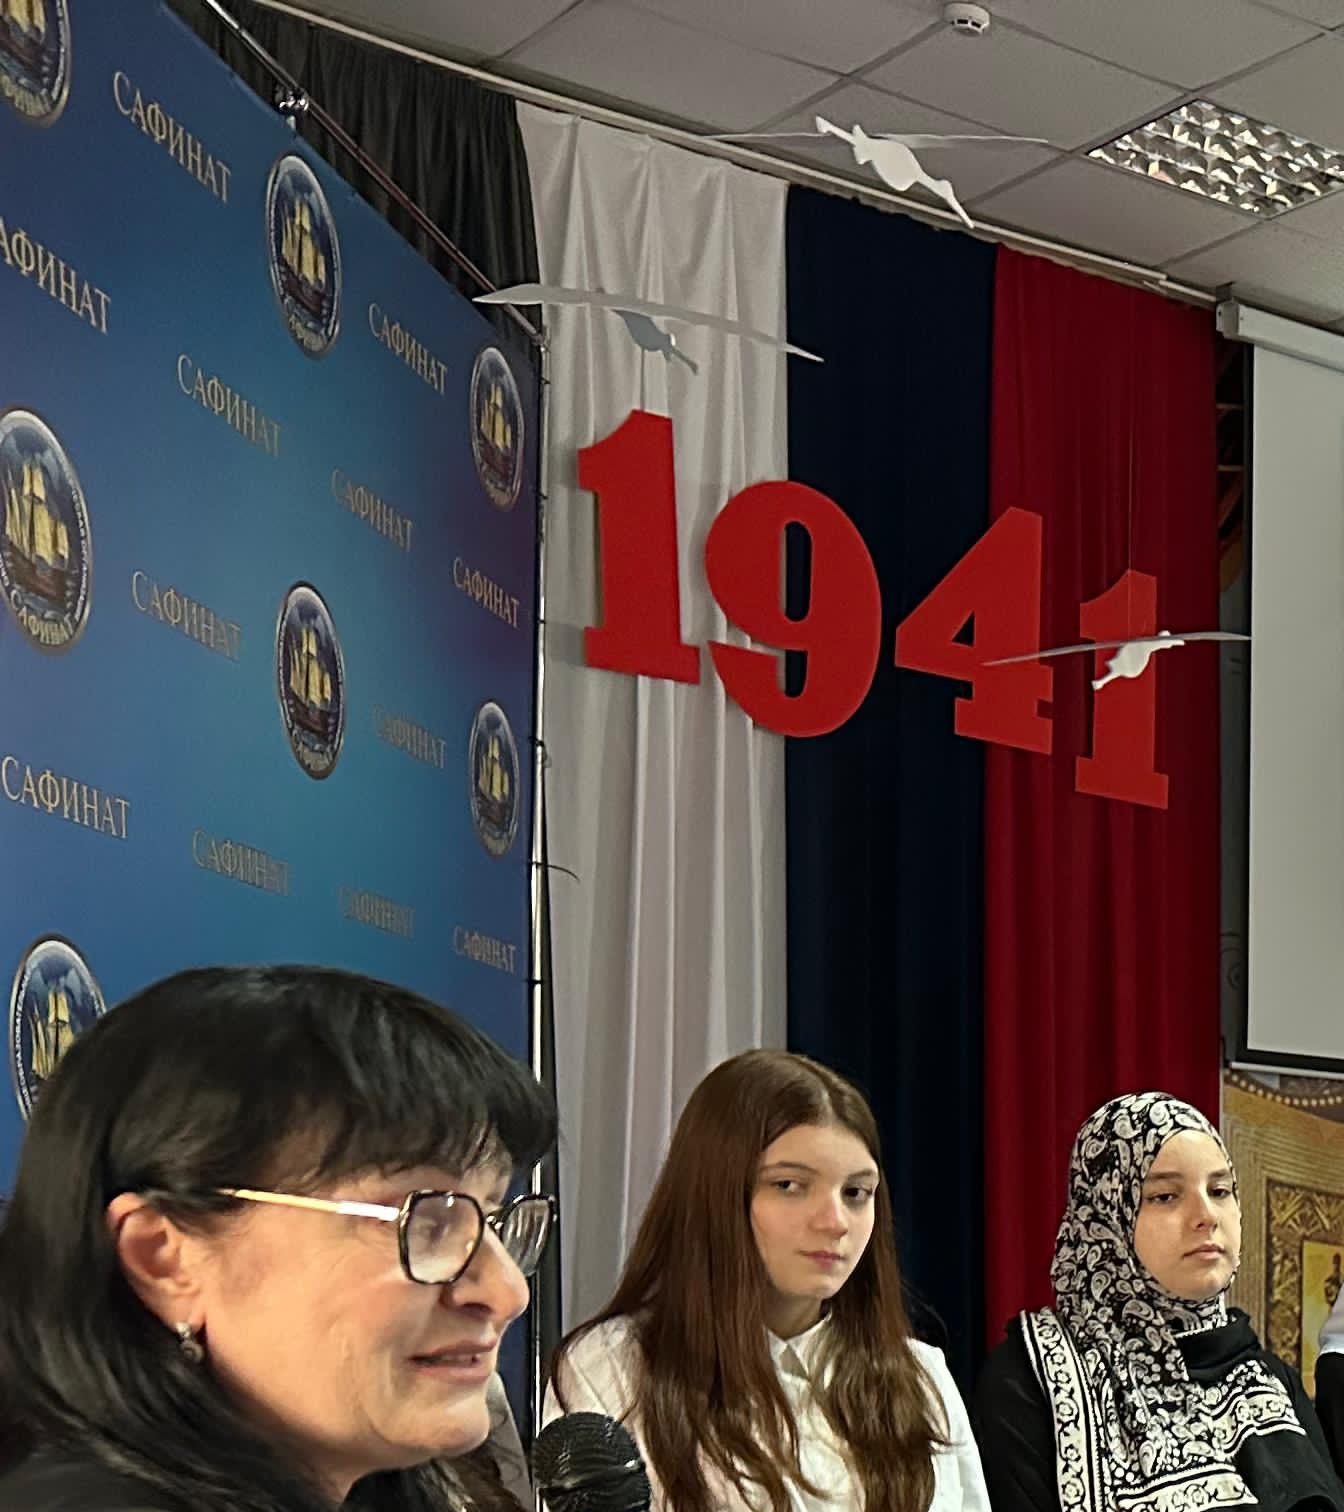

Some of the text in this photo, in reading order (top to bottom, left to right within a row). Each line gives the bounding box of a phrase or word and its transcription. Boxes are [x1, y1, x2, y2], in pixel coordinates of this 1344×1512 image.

[112, 71, 232, 203] САФИНАТ
[368, 302, 448, 396] САФИНАТ
[177, 354, 281, 457] САФИНАТ
[332, 469, 413, 552] САФИНАТ
[132, 570, 241, 662] САФИНАТ
[454, 557, 520, 631] САФИНАТ
[577, 409, 1168, 809] 1941
[373, 704, 448, 769] САФИНАТ
[1, 755, 130, 839] САФИНАТ
[193, 830, 290, 896] САФИНАТ
[454, 925, 517, 974] САФИНАТ
